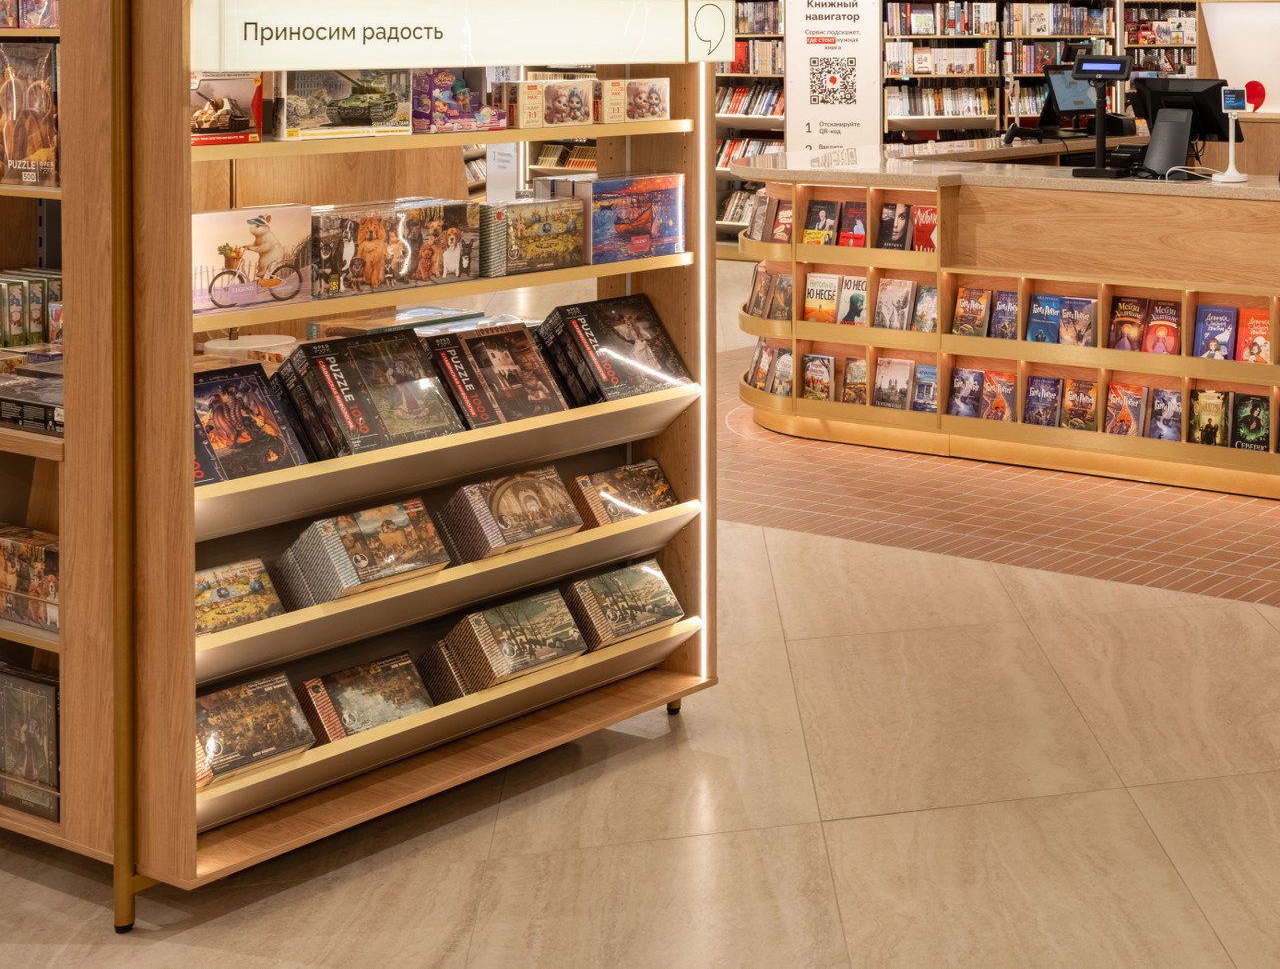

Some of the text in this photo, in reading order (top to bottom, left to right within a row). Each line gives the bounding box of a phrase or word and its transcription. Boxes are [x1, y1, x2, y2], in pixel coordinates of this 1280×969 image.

[805, 13, 861, 23] навигатор
[243, 21, 444, 46] Приносим радость
[819, 121, 861, 130] Отсканируйте
[8, 159, 36, 171] PUZZLE
[844, 279, 867, 292] Ю НЕС
[807, 288, 815, 299] Ю
[577, 316, 619, 385] PUZZLE 1000
[446, 348, 490, 422] PUZZLE 1000
[325, 355, 370, 435] PUZZLE 1000
